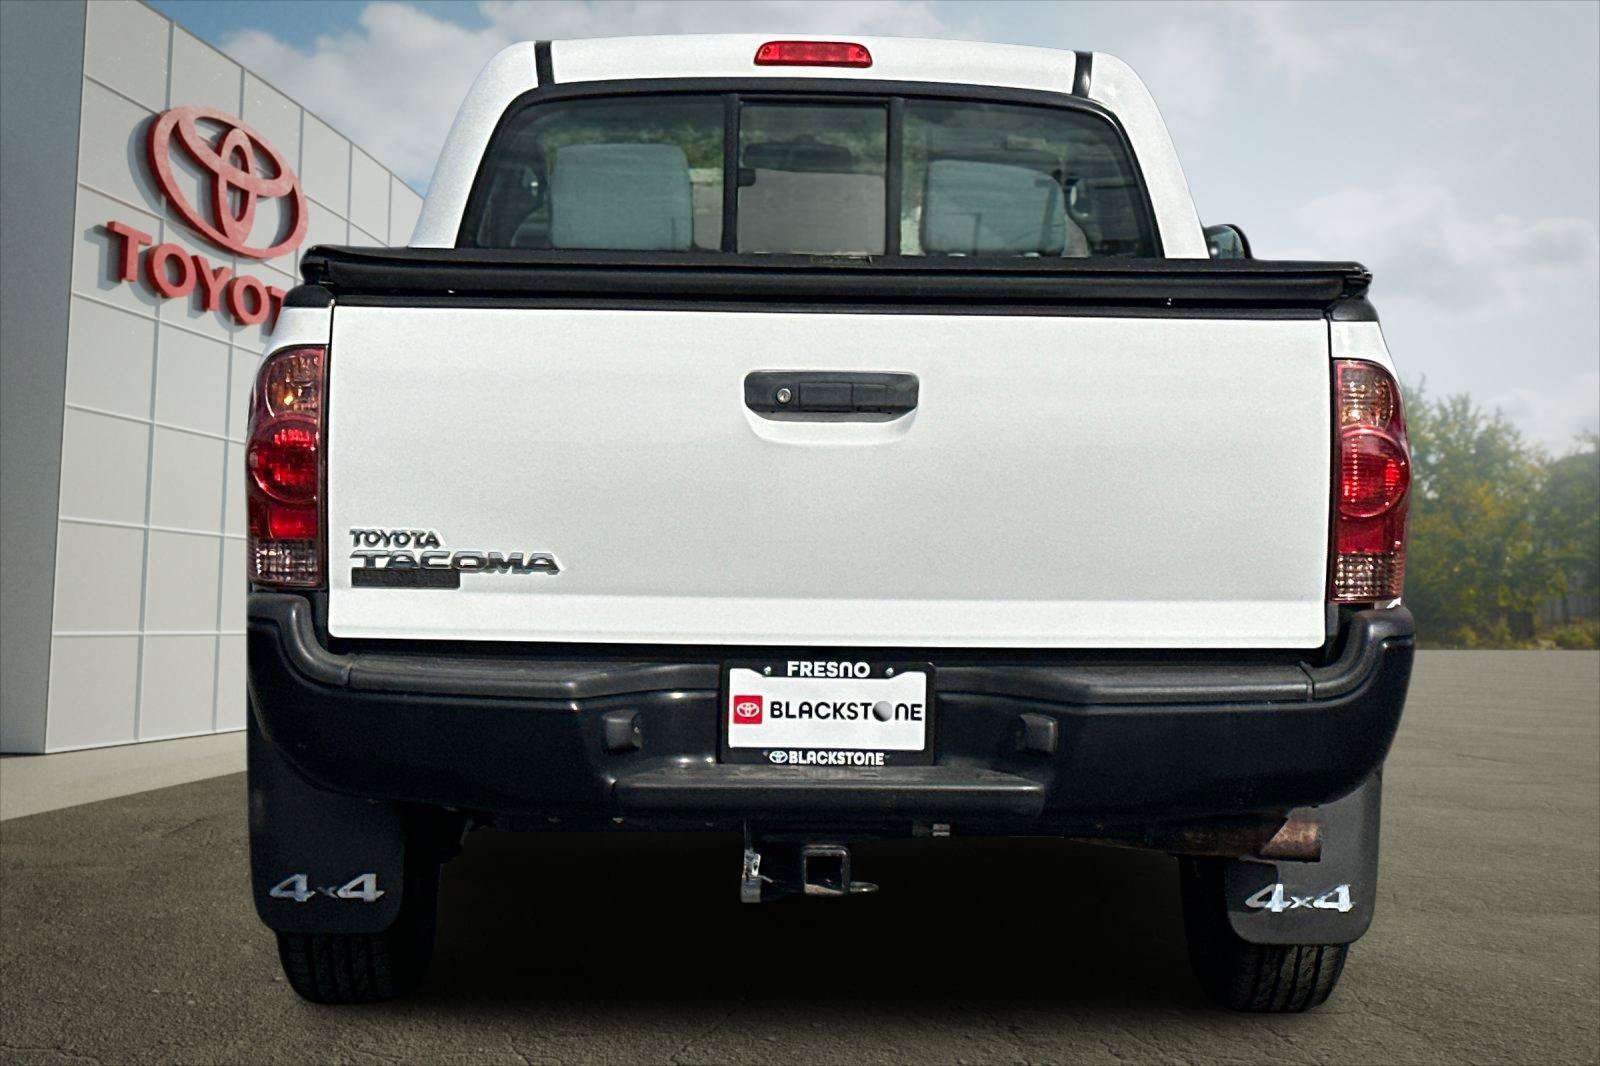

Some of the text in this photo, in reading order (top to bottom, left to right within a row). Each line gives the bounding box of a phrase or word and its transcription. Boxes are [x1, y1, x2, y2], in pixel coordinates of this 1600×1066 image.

[350, 529, 441, 549] TOYOTA
[350, 550, 561, 575] TACOMA
[787, 661, 871, 678] FRESNO
[770, 700, 923, 722] BLACKSTONE
[789, 750, 885, 766] BLACKSTONE
